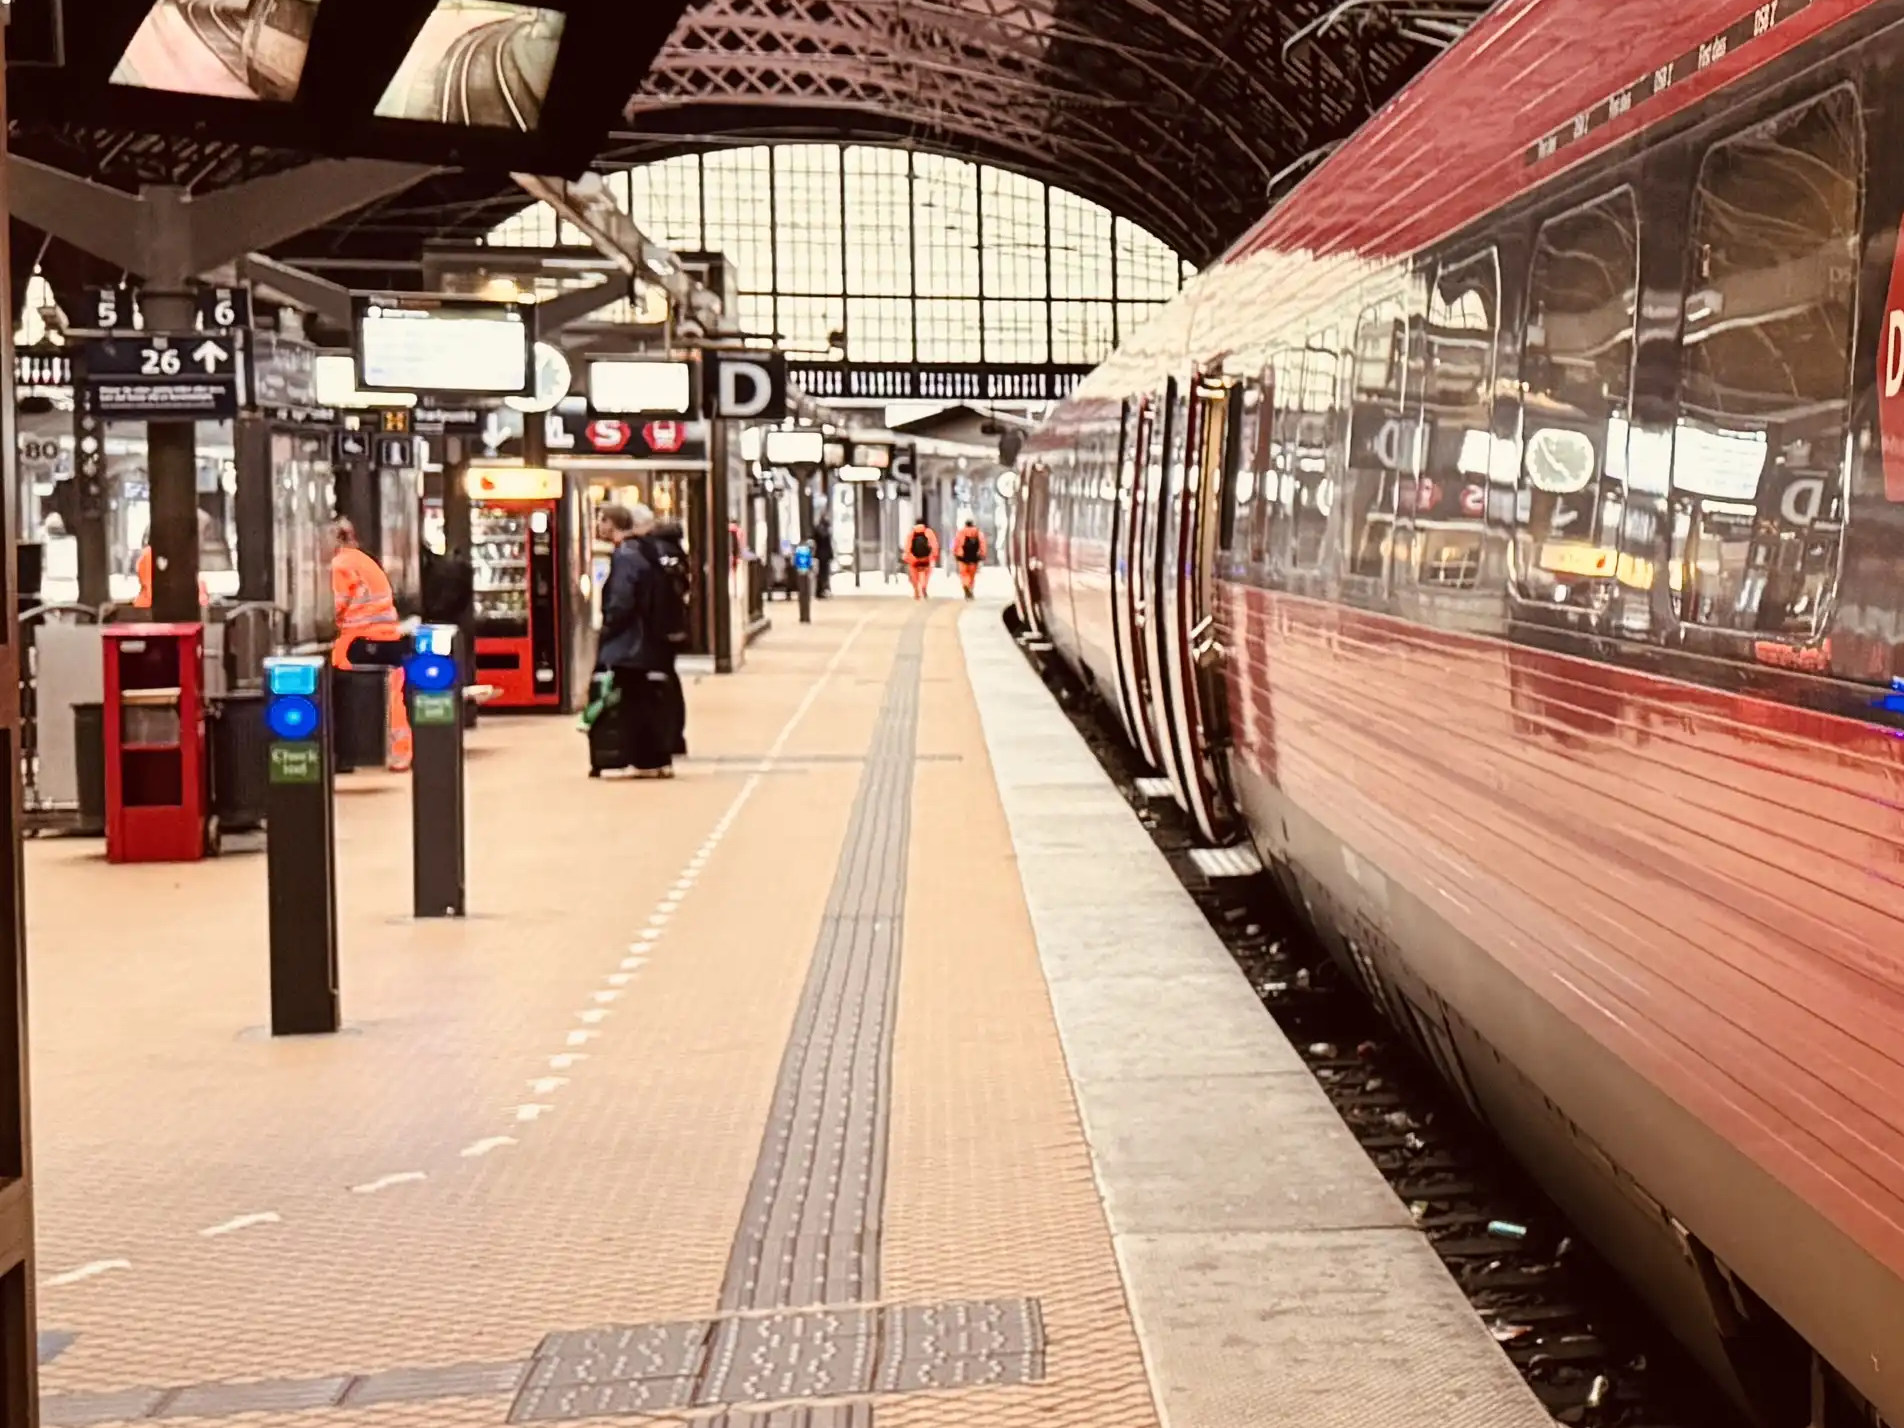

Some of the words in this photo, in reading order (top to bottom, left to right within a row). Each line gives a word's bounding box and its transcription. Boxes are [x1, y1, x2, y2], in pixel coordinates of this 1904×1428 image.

[98, 302, 118, 327] 5
[214, 300, 235, 326] 6
[141, 349, 181, 376] 26
[719, 361, 772, 417] D
